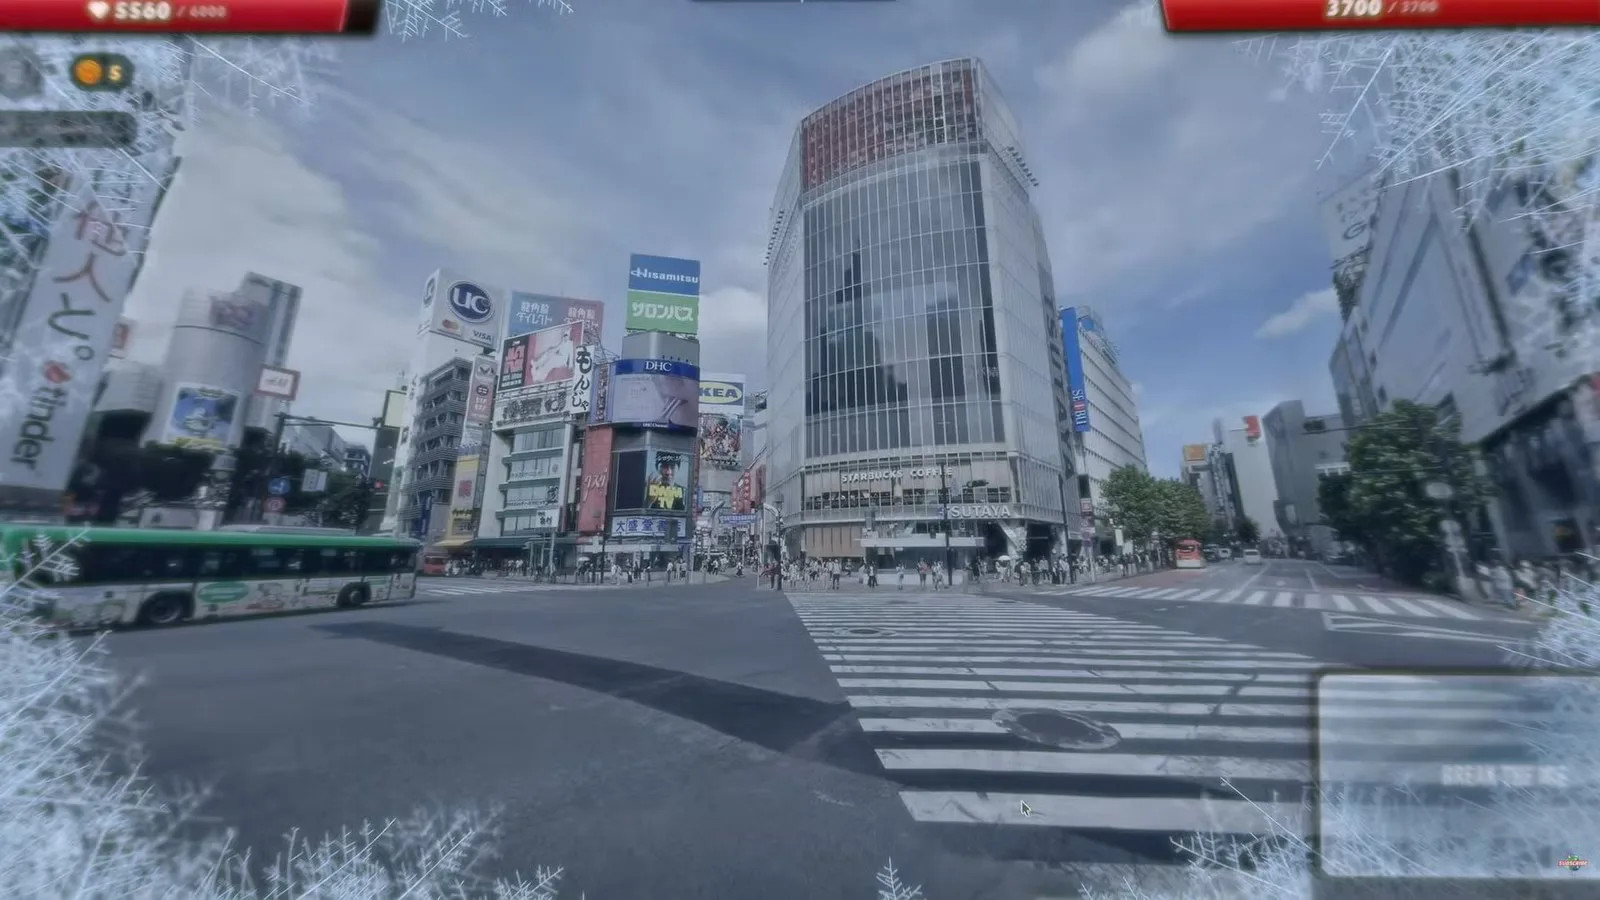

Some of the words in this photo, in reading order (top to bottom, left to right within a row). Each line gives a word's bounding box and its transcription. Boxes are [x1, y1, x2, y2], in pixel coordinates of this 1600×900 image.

[631, 268, 699, 284] Hisamitsu
[453, 286, 490, 314] UC
[631, 302, 694, 322] サロンパス
[473, 330, 493, 342] VISA
[645, 360, 673, 372] DHC
[699, 387, 738, 398] KEA
[10, 385, 67, 473] tinder
[841, 469, 903, 483] STARBUCKS
